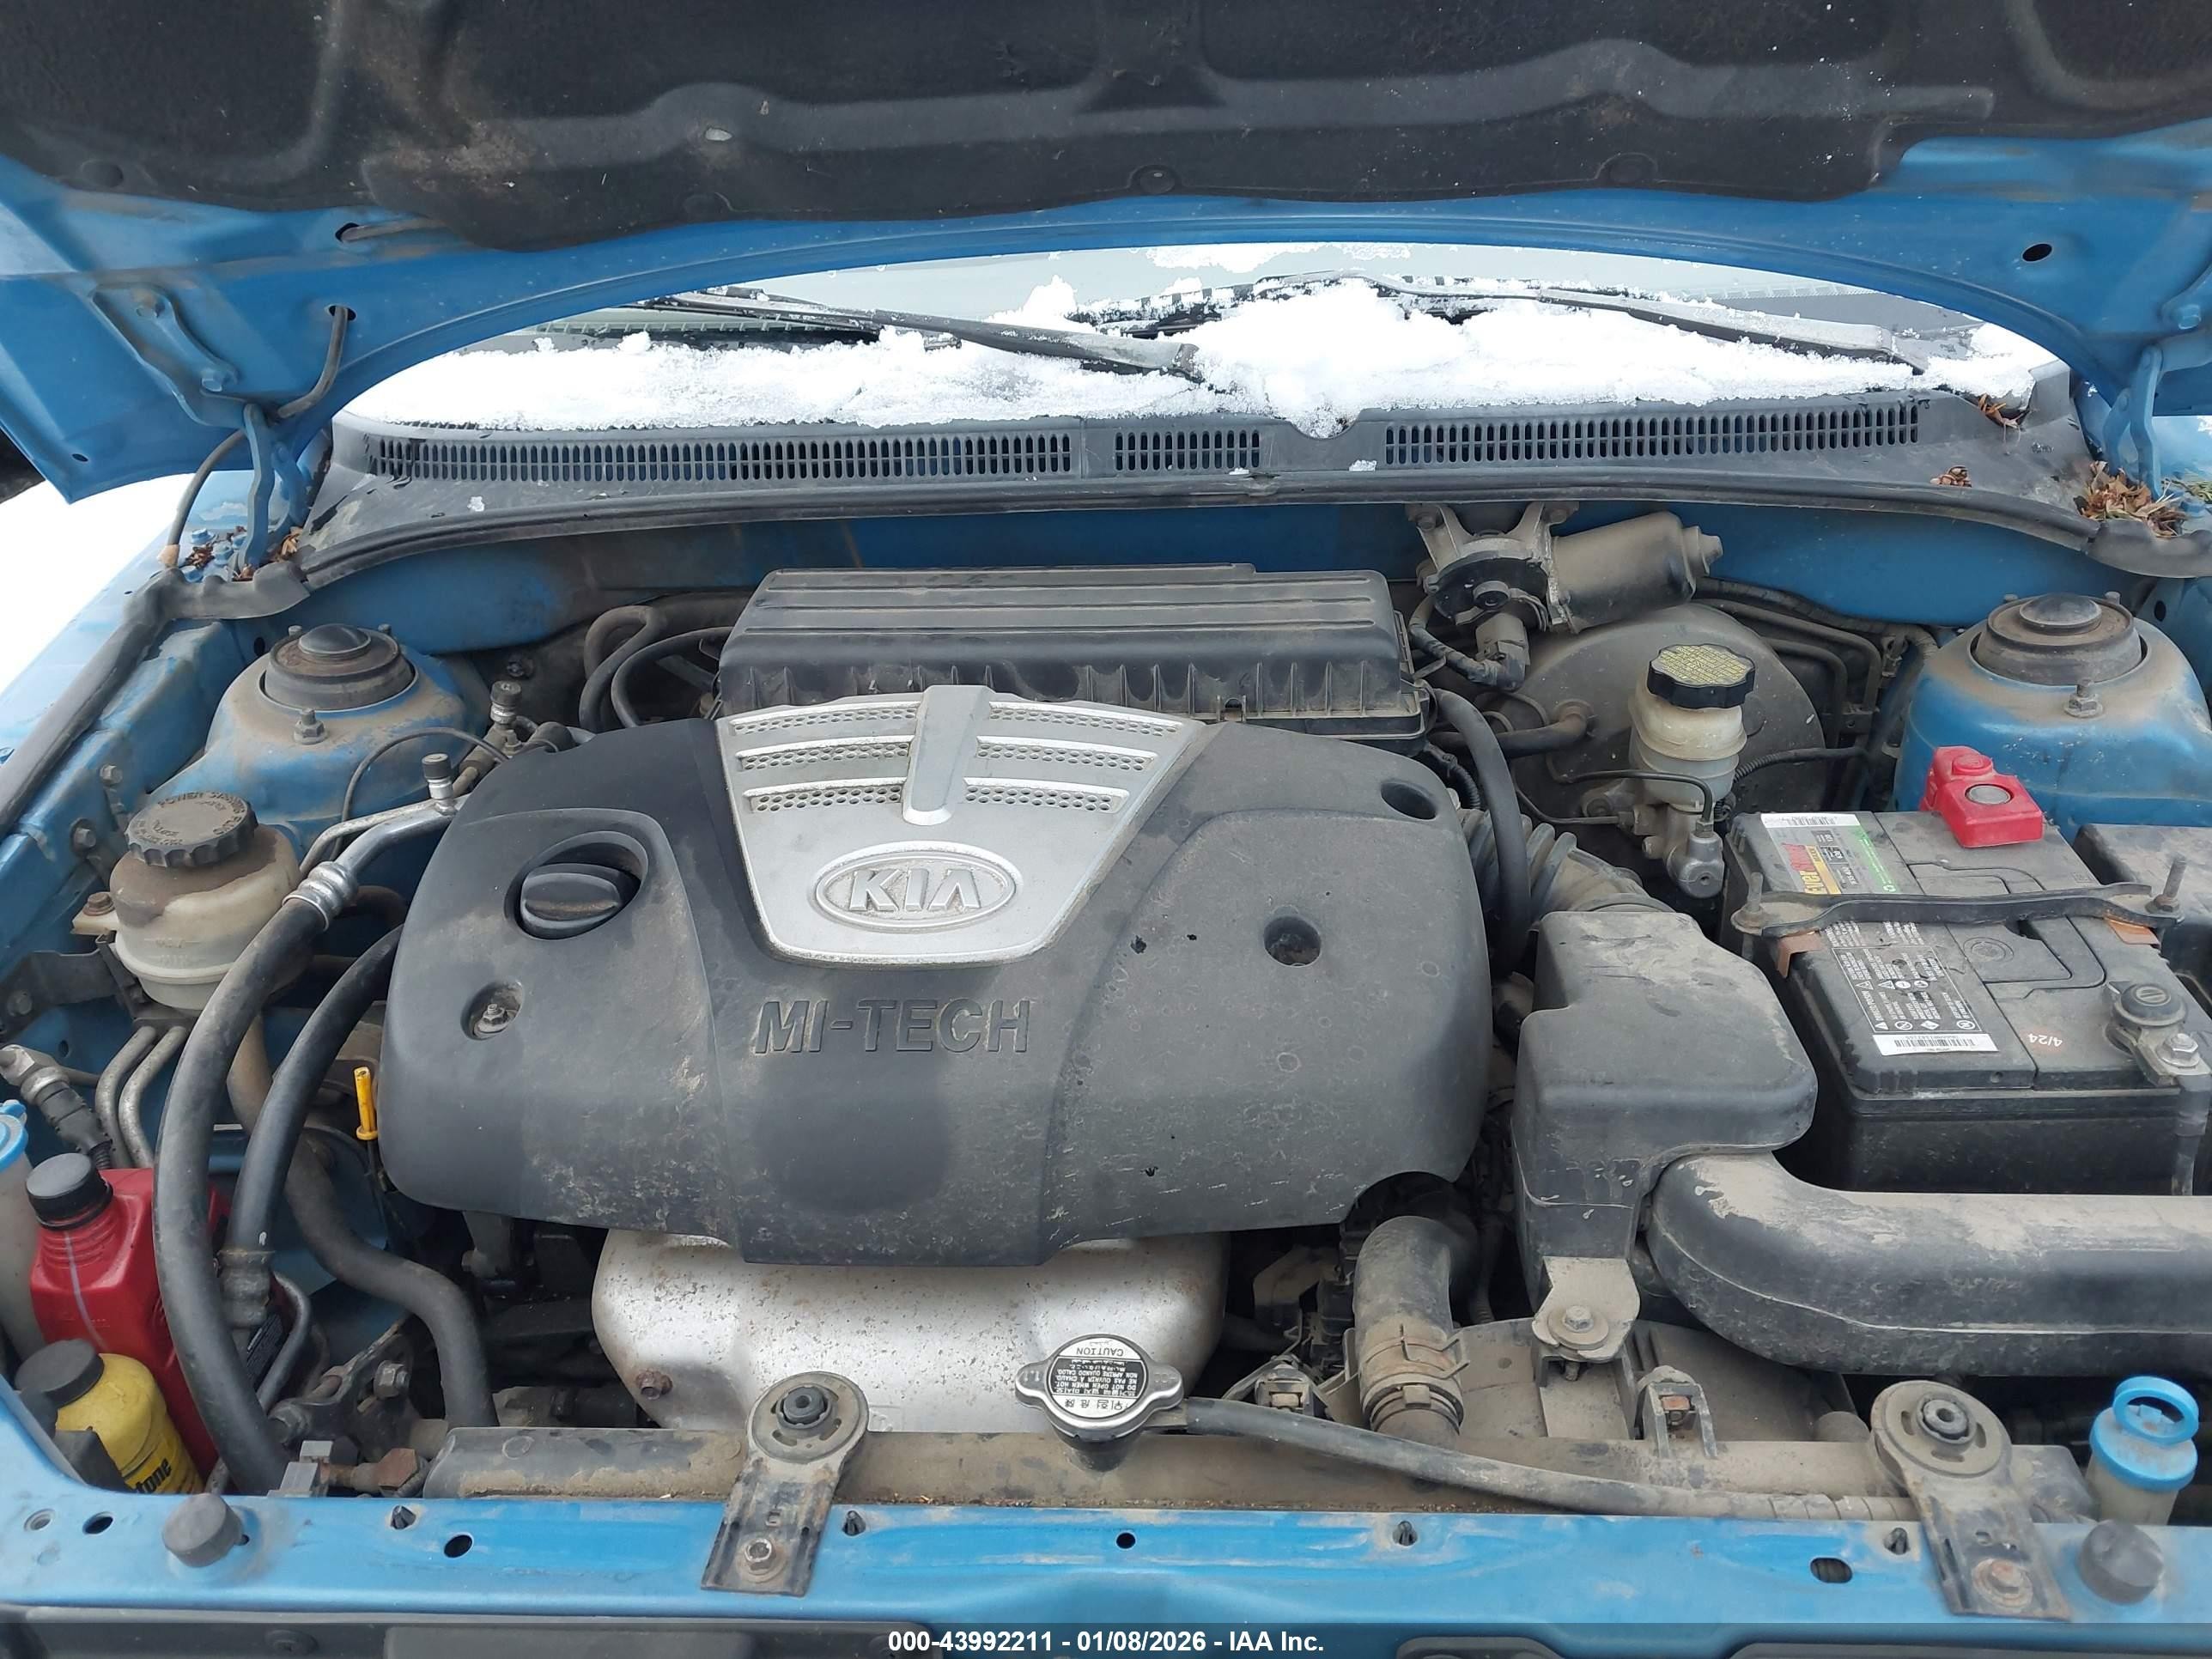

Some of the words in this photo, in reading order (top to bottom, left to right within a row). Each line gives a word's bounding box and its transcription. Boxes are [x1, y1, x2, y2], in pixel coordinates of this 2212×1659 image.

[848, 867, 981, 912] KIA
[752, 999, 1031, 1054] MI-TECH
[2027, 1033, 2063, 1048] 4/24
[1076, 1347, 1124, 1357] CAUTION
[1097, 1400, 1122, 1410] 위험
